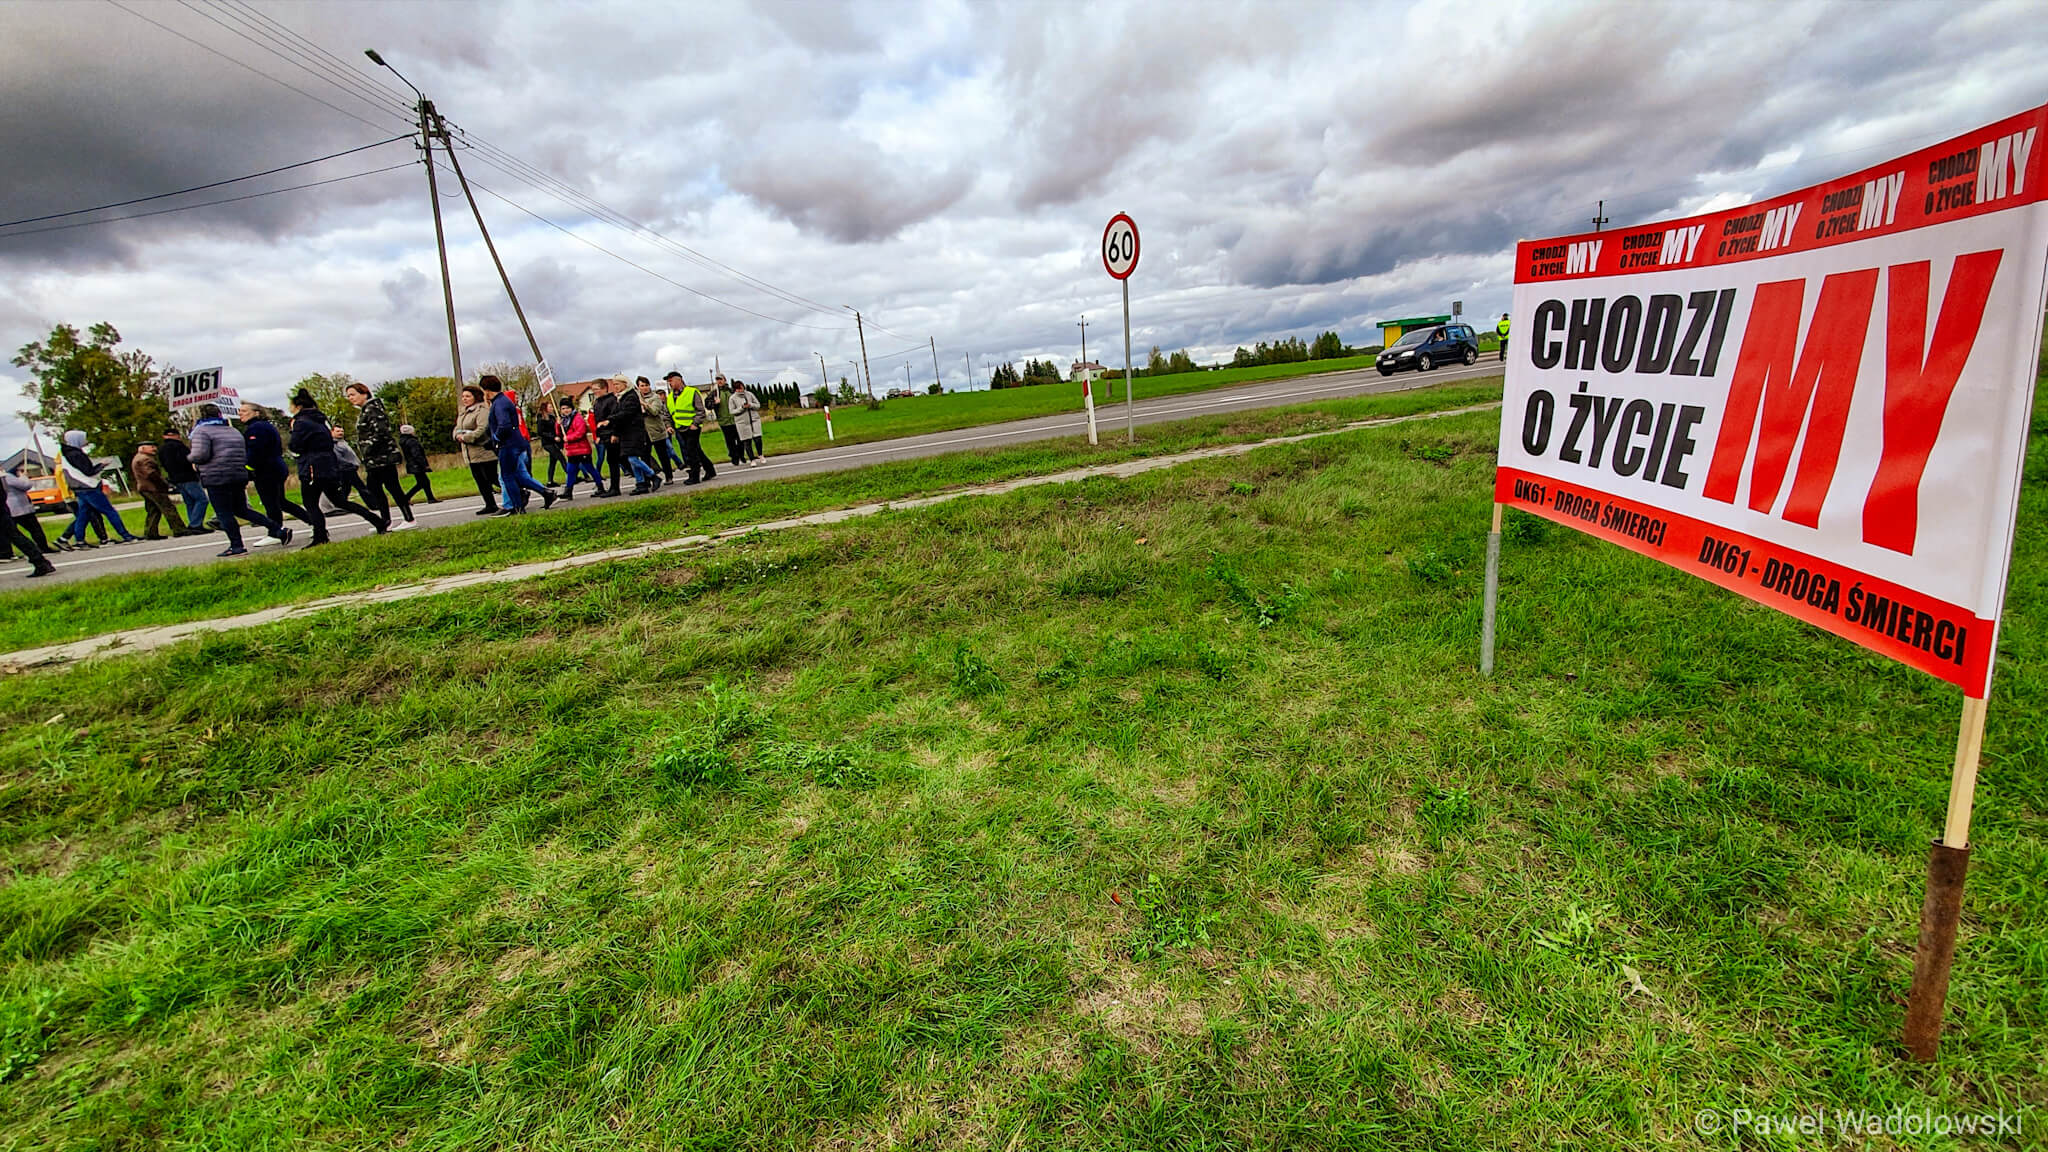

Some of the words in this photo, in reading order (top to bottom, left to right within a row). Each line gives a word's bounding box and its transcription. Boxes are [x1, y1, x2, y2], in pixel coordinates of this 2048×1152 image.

[1928, 147, 1978, 184] CHODZI
[1975, 127, 2038, 204] MY
[1821, 185, 1863, 214] CHODZI
[1857, 170, 1905, 232] MY
[1924, 191, 1934, 215] O
[1935, 181, 1974, 213] ŻYCIE
[1623, 232, 1663, 250] CHODZI
[1723, 212, 1765, 236] CHODZI
[1757, 201, 1803, 252] MY
[1816, 220, 1825, 239] O
[1825, 212, 1857, 237] ŻYCIE
[1108, 231, 1133, 263] 60
[1532, 245, 1566, 261] CHODZI
[1566, 240, 1603, 274] MY
[1620, 255, 1627, 268] O
[1628, 250, 1659, 268] ŻYCIE
[1658, 224, 1706, 265] MY
[1718, 241, 1727, 257] O
[1727, 234, 1758, 256] ŻYCIE
[1531, 264, 1537, 276] O
[1538, 261, 1564, 276] ŻYCIE
[1531, 288, 1737, 377] CHODZI
[174, 370, 219, 397] DK61
[1702, 248, 2004, 556] MY
[1522, 389, 1555, 456] O
[1559, 381, 1705, 490] ŻYCIE
[1514, 479, 1547, 506] DK61
[1554, 490, 1600, 524] DROGA
[1601, 501, 1667, 547] ŚMIERCI
[1698, 536, 1751, 578] DK61
[1761, 557, 1840, 615] DROGA
[1845, 582, 1967, 666] ŚMIERCI
